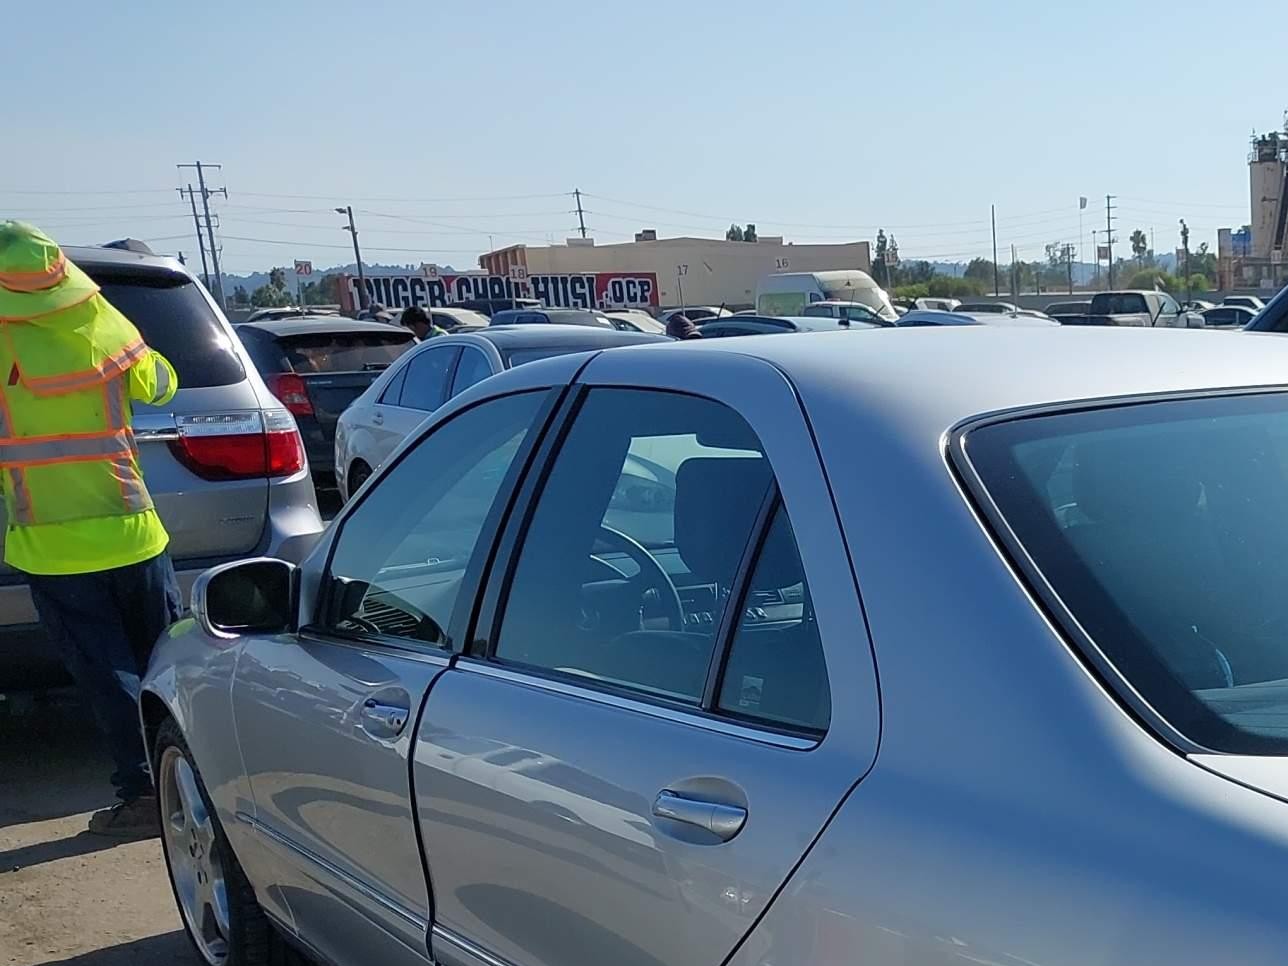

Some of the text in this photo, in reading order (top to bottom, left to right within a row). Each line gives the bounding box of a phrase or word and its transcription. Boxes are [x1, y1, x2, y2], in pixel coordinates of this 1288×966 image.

[295, 263, 312, 275] 20
[775, 258, 789, 269] 16
[422, 266, 438, 278] 19
[510, 268, 525, 280] 18
[677, 264, 689, 276] 17
